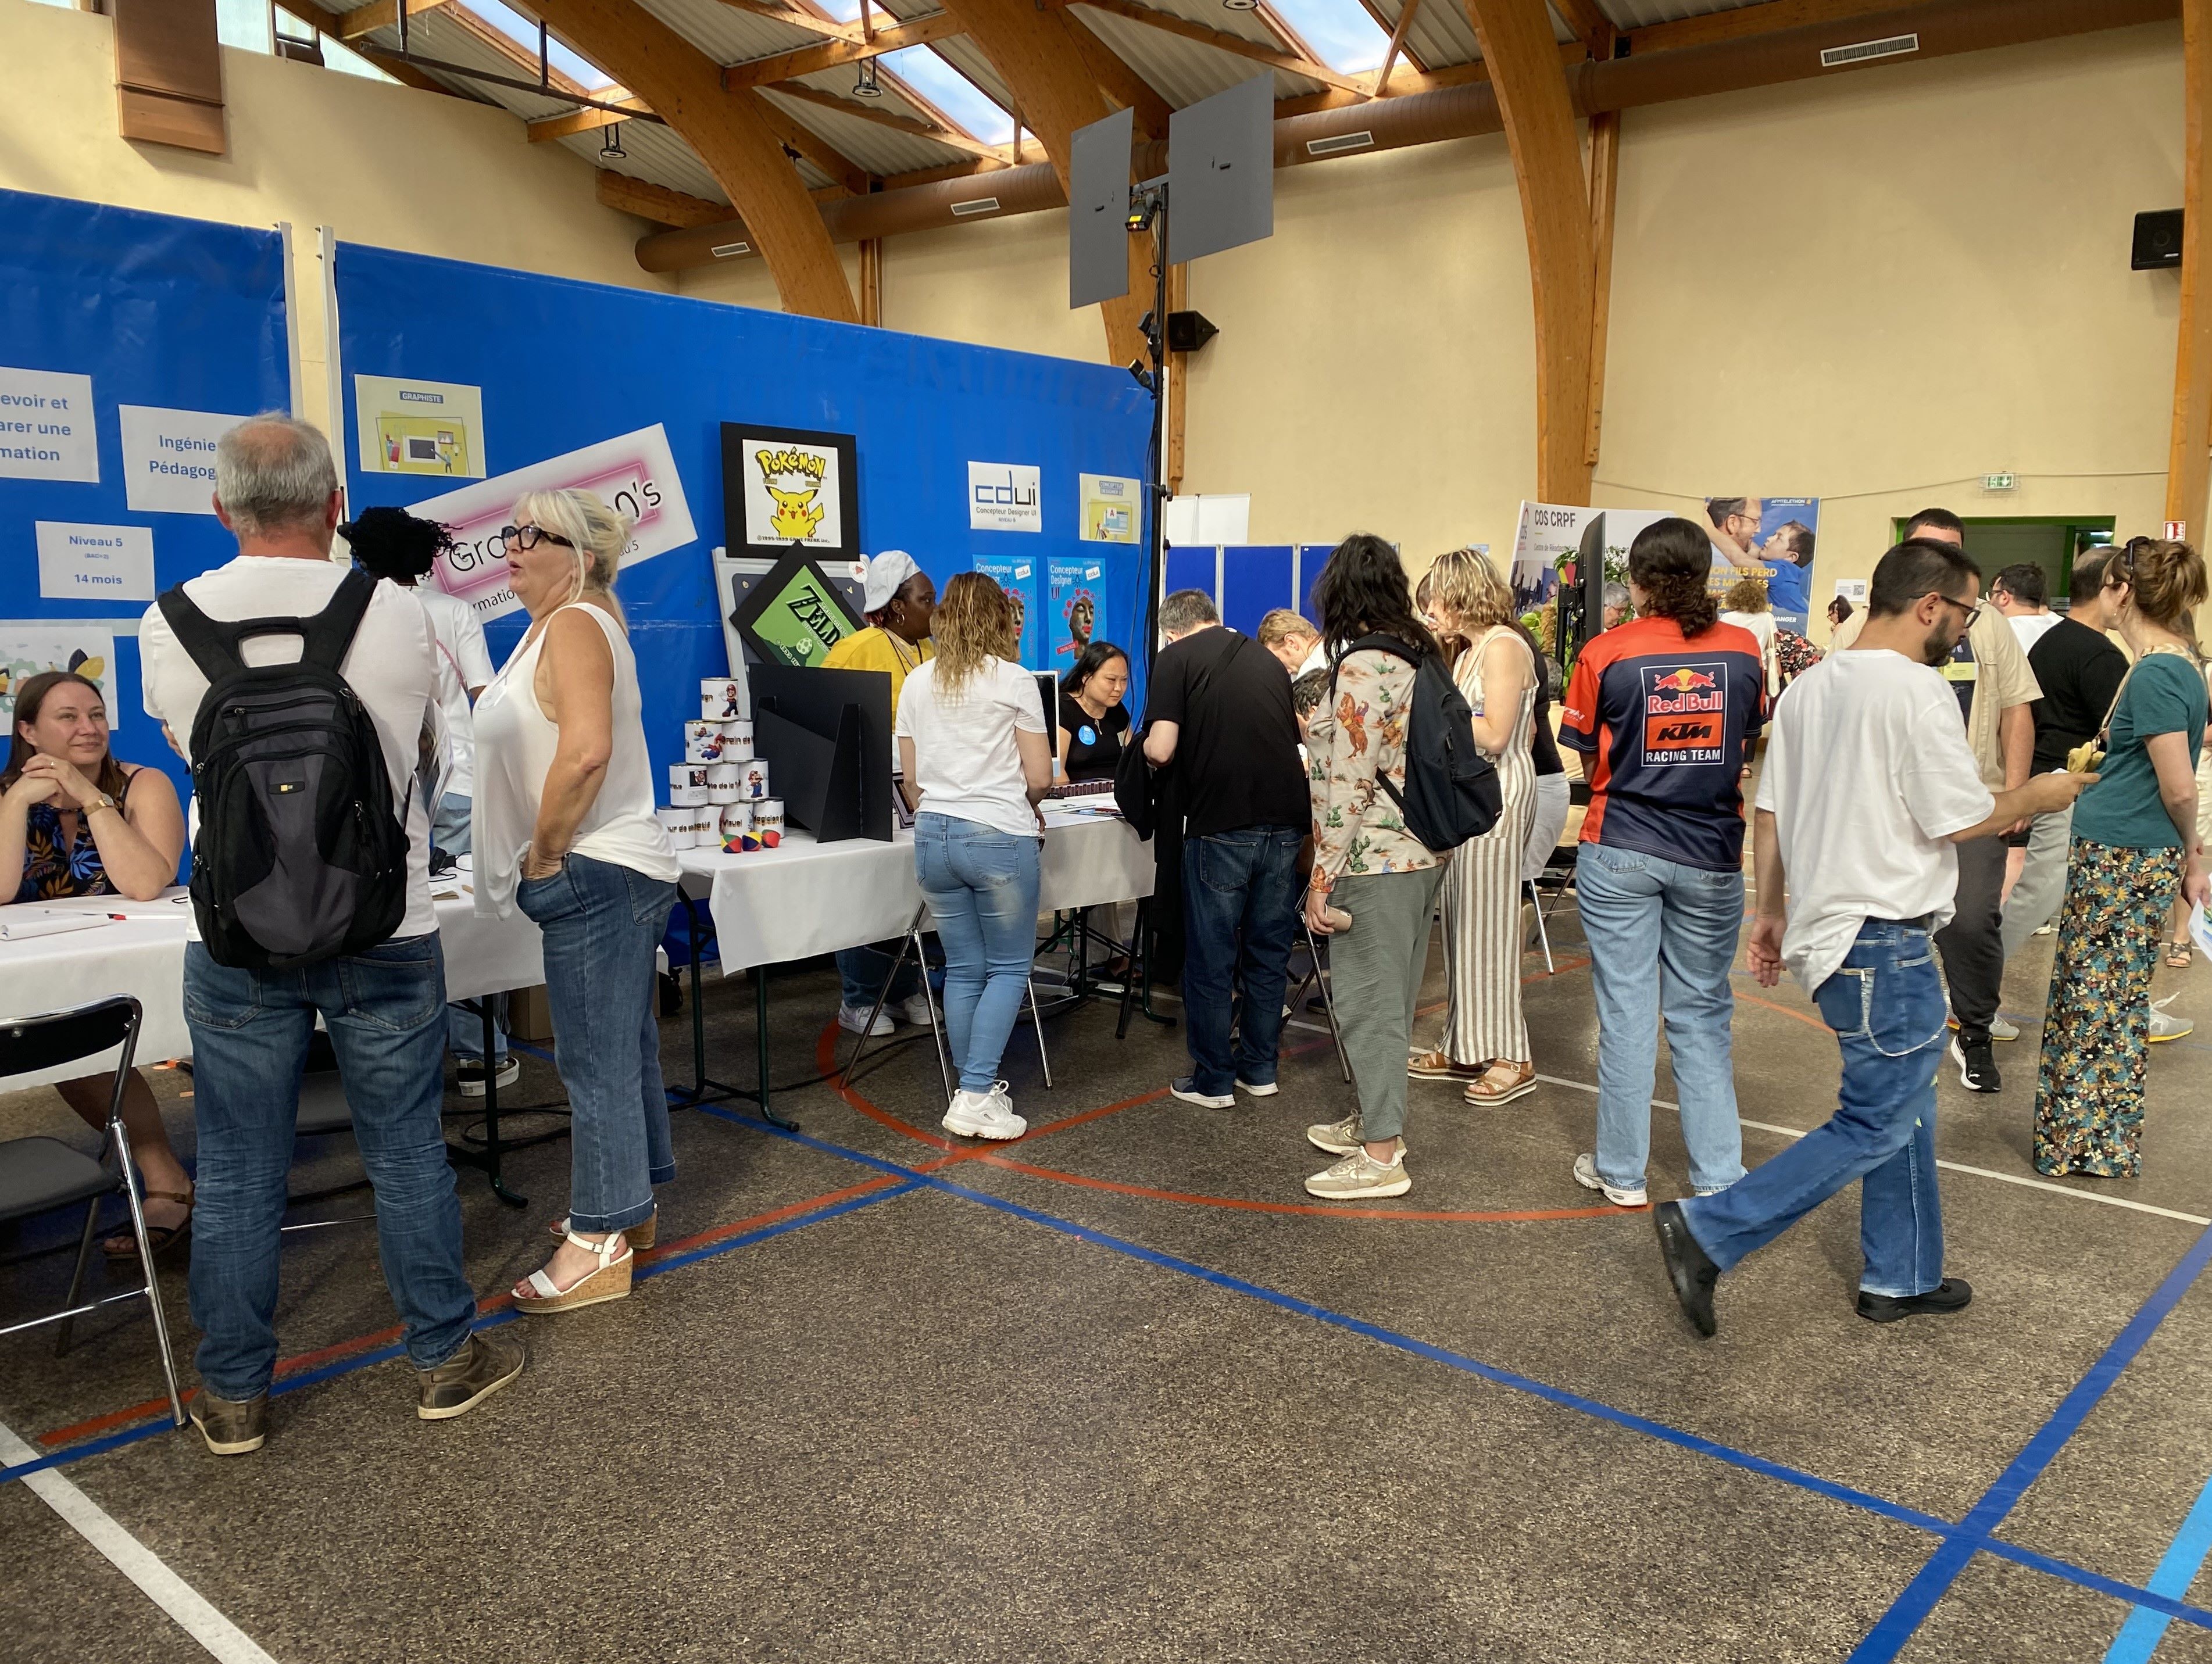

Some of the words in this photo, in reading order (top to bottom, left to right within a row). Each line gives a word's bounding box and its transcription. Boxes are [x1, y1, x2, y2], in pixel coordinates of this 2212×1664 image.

[1, 394, 45, 407] evoir
[51, 398, 68, 410] et
[402, 393, 441, 403] GRAPHISTE
[38, 424, 71, 435] une
[159, 435, 216, 452] Ingénie
[149, 460, 216, 479] Pédagog
[976, 506, 1006, 515] Concepteur
[1008, 509, 1030, 517] Designer
[1535, 510, 1549, 525] COS
[1550, 511, 1575, 527] CRPF
[69, 535, 112, 546] Niveau
[116, 538, 123, 547] 5
[976, 563, 1012, 574] Concepteur
[1050, 565, 1083, 575] Concepteur
[1730, 567, 1749, 577] FILS
[1752, 567, 1778, 577] PERD
[74, 574, 88, 583] 14
[92, 575, 122, 584] mois
[1050, 575, 1072, 587] Designer
[472, 589, 515, 611] rmatio
[1051, 586, 1060, 600] UI
[786, 583, 841, 650] ZELD
[1648, 693, 1685, 714] Red
[1686, 691, 1723, 711] Bull
[1656, 721, 1713, 741] KTM
[1646, 750, 1686, 763] RACING
[1691, 749, 1721, 761] TEAM
